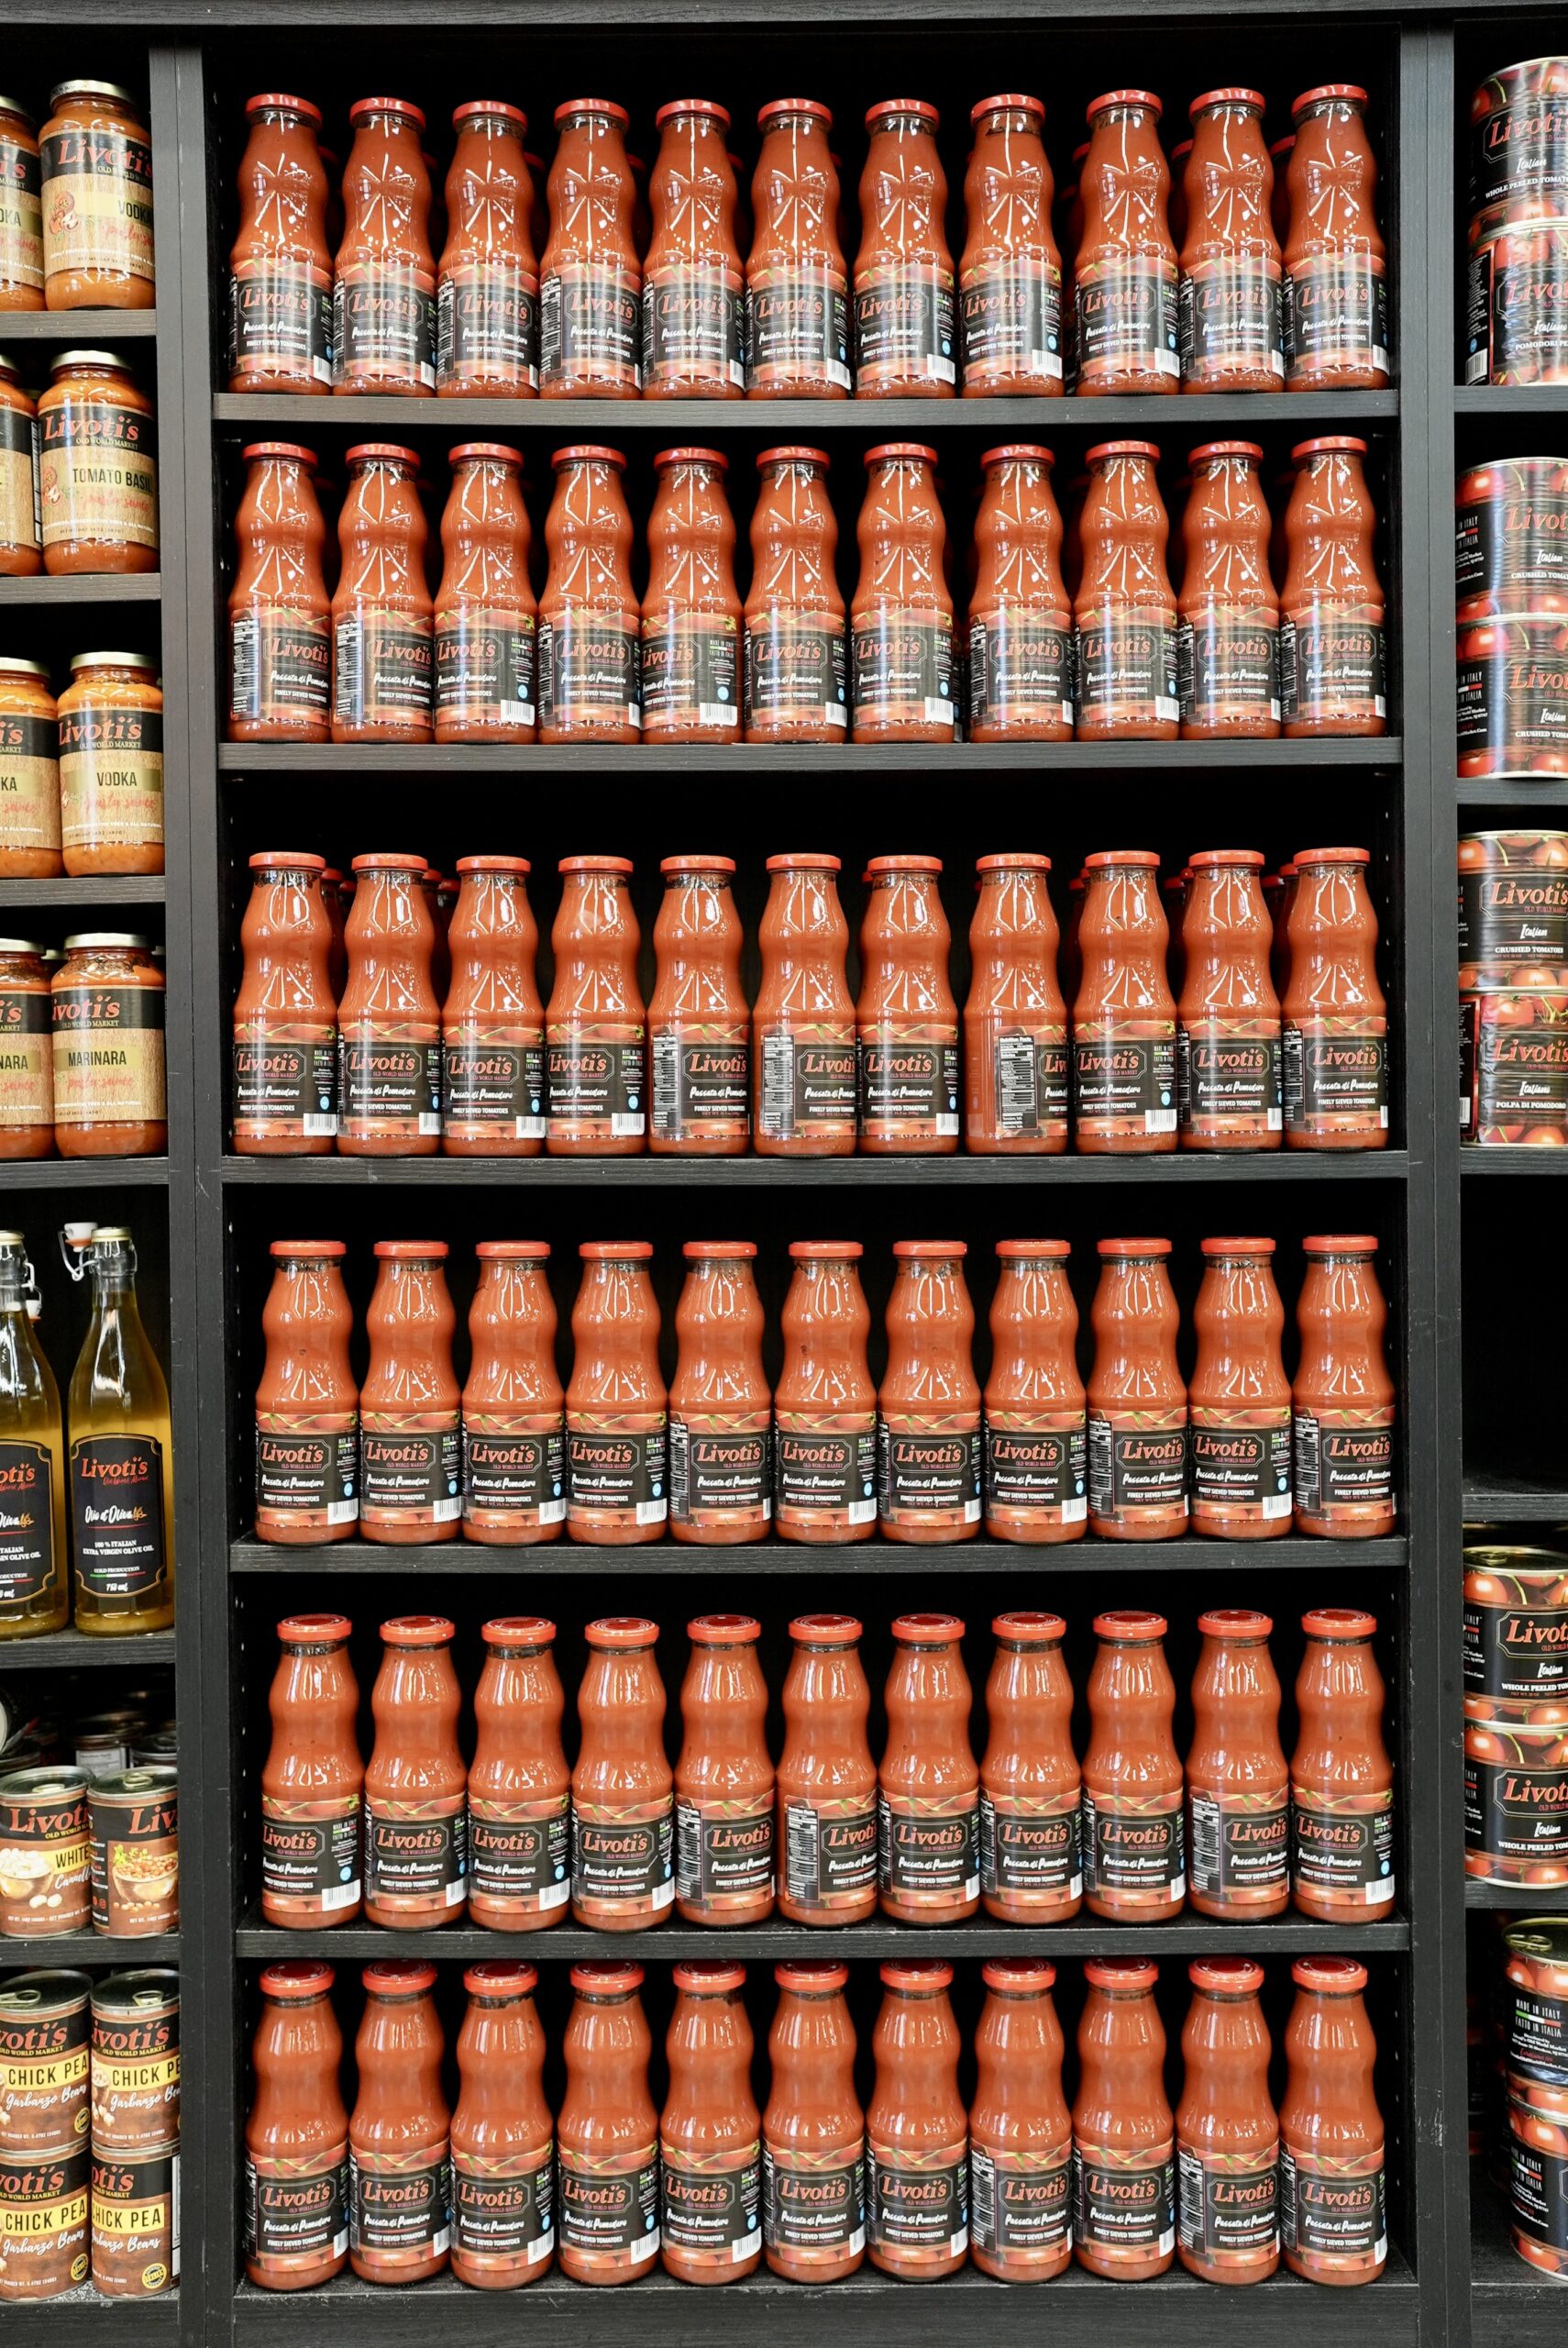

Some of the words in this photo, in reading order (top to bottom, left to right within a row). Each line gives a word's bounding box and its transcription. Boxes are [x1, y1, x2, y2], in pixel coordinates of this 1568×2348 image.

[1516, 157, 1547, 173] Italian
[243, 288, 309, 310] Livoti's
[351, 294, 417, 316] Livoti's
[662, 292, 726, 313] Livoti's
[861, 293, 922, 319] Livoti's
[966, 289, 1026, 318] Livoti's
[1086, 285, 1149, 313] Livoti's
[44, 414, 138, 440] Livoti's
[73, 469, 121, 484] TOMATO
[127, 471, 152, 493] BASIL
[1536, 549, 1563, 564] Italian
[561, 638, 624, 659] Livoti's
[757, 641, 821, 661] Livoti's
[859, 637, 920, 659] Livoti's
[996, 638, 1058, 659] Livoti's
[1203, 635, 1268, 656] Livoti's
[1306, 634, 1371, 654] Livoti's
[1540, 708, 1566, 724] Italian
[59, 715, 141, 745] Livoti's
[97, 771, 137, 787] VODKA
[1520, 924, 1548, 939] Italian
[51, 995, 120, 1022] ivoti's
[68, 1050, 127, 1067] MARINARA
[238, 1052, 299, 1072] Livoti's
[349, 1051, 414, 1070] Livoti's
[449, 1053, 512, 1074] Livoti's
[868, 1055, 932, 1073] Livoti's
[1080, 1049, 1139, 1072] Livoti's
[1198, 1047, 1264, 1068] Livoti's
[1313, 1047, 1376, 1067] Livoti's
[261, 1442, 323, 1463] Livoti's
[367, 1443, 429, 1462] Livoti's
[471, 1443, 536, 1464] Livoti's
[571, 1440, 632, 1462] Livoti's
[697, 1443, 760, 1463] Livoti's
[897, 1443, 961, 1463] Livoti's
[994, 1434, 1057, 1462] Livoti's
[1196, 1436, 1257, 1457] Livoti's
[82, 1456, 148, 1478] Livoti's
[9, 1553, 29, 1561] OLIVE
[1538, 1663, 1563, 1678] Italian
[1502, 1683, 1529, 1691] WHOLE
[1531, 1683, 1557, 1691] PEELED
[378, 1828, 442, 1848] Livoti's
[474, 1828, 536, 1848] Livoti's
[712, 1823, 770, 1848] Livoti's
[899, 1824, 962, 1844] Livoti's
[1003, 1824, 1067, 1844] Livoti's
[1103, 1824, 1167, 1844] Livoti's
[1298, 1816, 1360, 1843] Livoti's
[1534, 1822, 1561, 1837] Italian
[583, 1831, 647, 1852] Livoti's
[1498, 1841, 1527, 1850] WHOLE
[1528, 1842, 1554, 1851] PEELED
[56, 1844, 88, 1868] WHITE
[1542, 2007, 1560, 2020] ITALY
[11, 2047, 34, 2055] WORLD
[36, 2045, 63, 2054] MARKET
[115, 2048, 138, 2056] WORLD
[139, 2045, 166, 2054] MARKET
[9, 2066, 56, 2085] CHICK
[64, 2054, 87, 2078] PEA
[112, 2066, 160, 2086] CHICK
[32, 2189, 61, 2199] MARKET
[105, 2189, 130, 2198] MARKET
[265, 2183, 329, 2208] Livoti's
[365, 2180, 429, 2202] Livoti's
[460, 2183, 523, 2206] Livoti's
[565, 2176, 625, 2203] Livoti's
[667, 2176, 726, 2201] Livoti's
[882, 2176, 946, 2199] Livoti's
[1089, 2175, 1155, 2198] Livoti's
[1306, 2182, 1371, 2207] Livoti's
[6, 2211, 52, 2231] CHICK
[61, 2199, 85, 2223] PEA
[131, 2209, 160, 2228] PEA
[58, 2229, 85, 2250] Beans
[127, 2237, 160, 2253] Beans
[401, 2230, 426, 2241] TOMATOES
